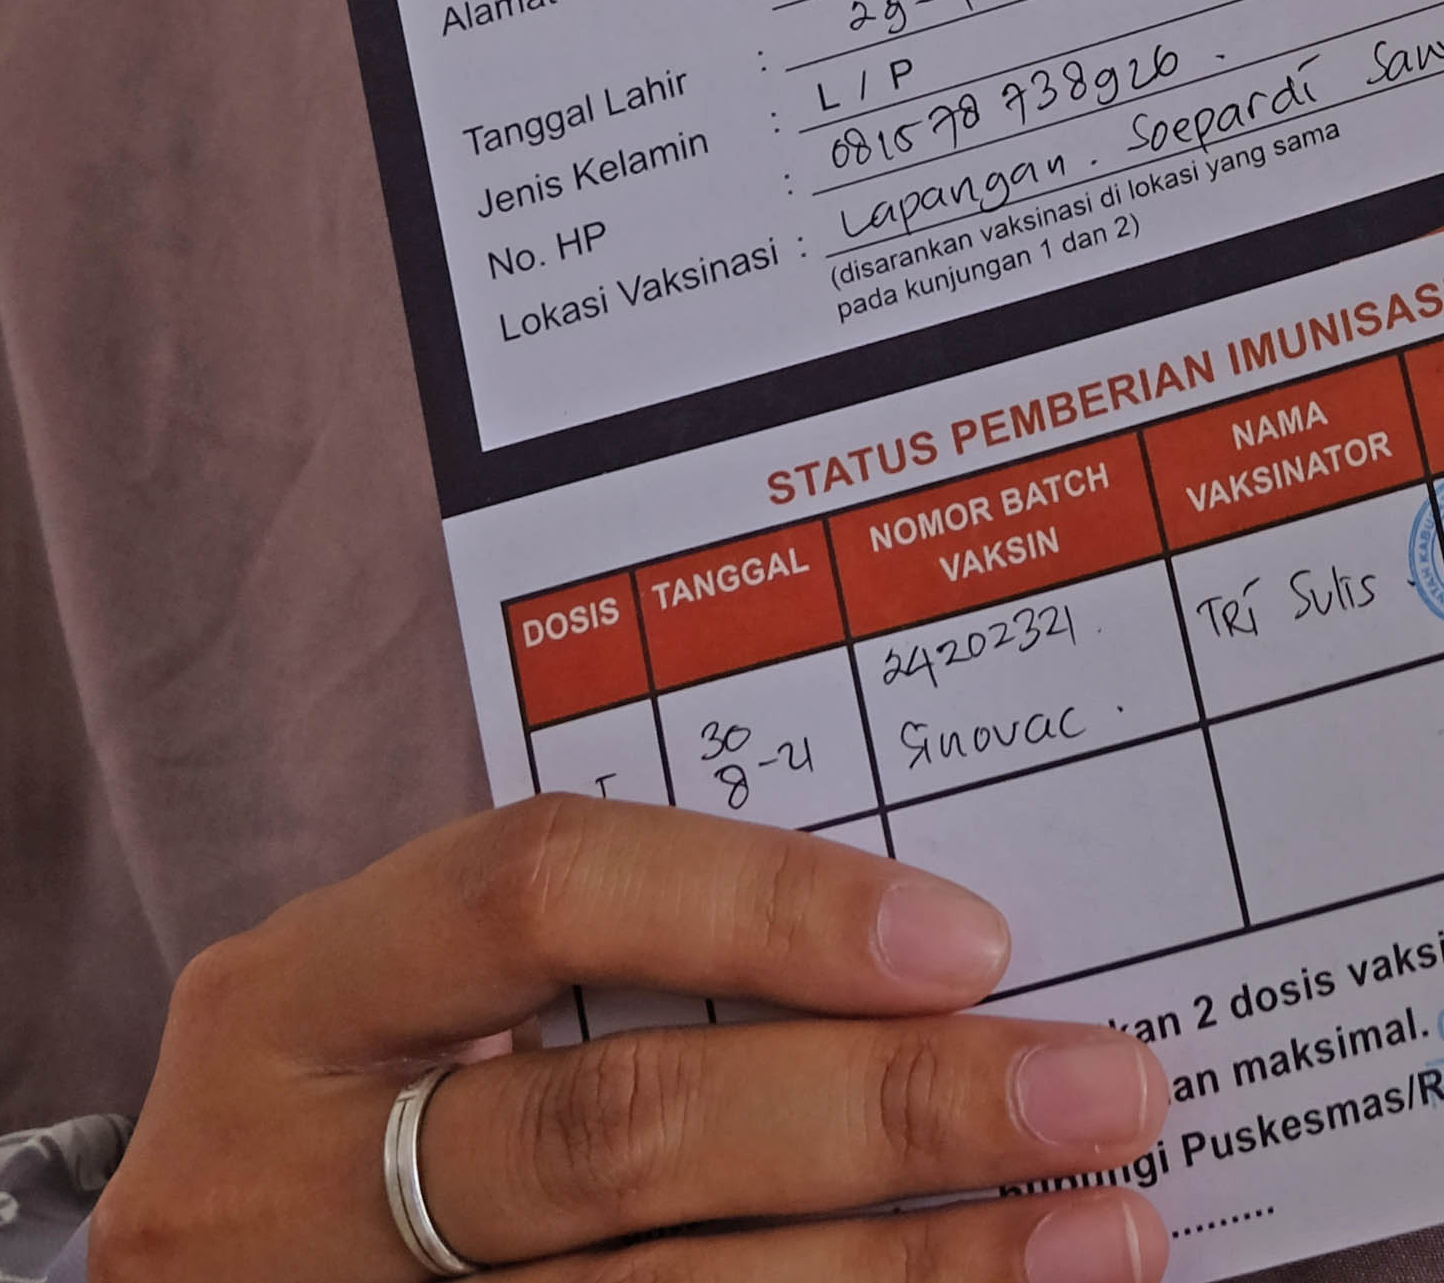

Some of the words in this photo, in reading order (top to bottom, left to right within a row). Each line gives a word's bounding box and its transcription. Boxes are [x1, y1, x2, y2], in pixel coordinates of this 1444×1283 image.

[463, 94, 594, 155] Tanggal
[605, 70, 687, 116] Lahir
[477, 174, 563, 218] Jenis
[574, 132, 708, 190] Kelamin
[831, 234, 973, 291] (disarankan
[980, 192, 1093, 244] vaksinasi
[1100, 183, 1123, 211] di
[1129, 162, 1199, 199] lokasi
[1205, 144, 1265, 184] yang
[1273, 122, 1340, 157] sama
[488, 247, 545, 279] No.
[556, 221, 606, 260] HP
[500, 286, 608, 342] Lokasi
[617, 237, 778, 307] Vaksinasi
[837, 287, 898, 324] pada
[907, 248, 1031, 301] kunjungan
[1041, 242, 1053, 261] 1
[1063, 231, 1105, 252] dan
[1114, 212, 1140, 239] 2)
[766, 432, 938, 506] STATUS
[951, 360, 1217, 456] PEMBERIAN
[1232, 401, 1328, 450] NAMA
[870, 496, 993, 552] NOMOR
[1001, 463, 1109, 515] BATCH
[1186, 431, 1392, 512] VAKSINATOR
[652, 547, 810, 610] TANGGAL
[939, 527, 1059, 582] VAKSIN
[523, 597, 620, 648] DOSIS
[1194, 995, 1217, 1030] 2
[1230, 966, 1335, 1019] dosis
[1234, 1007, 1429, 1087] maksimal.
